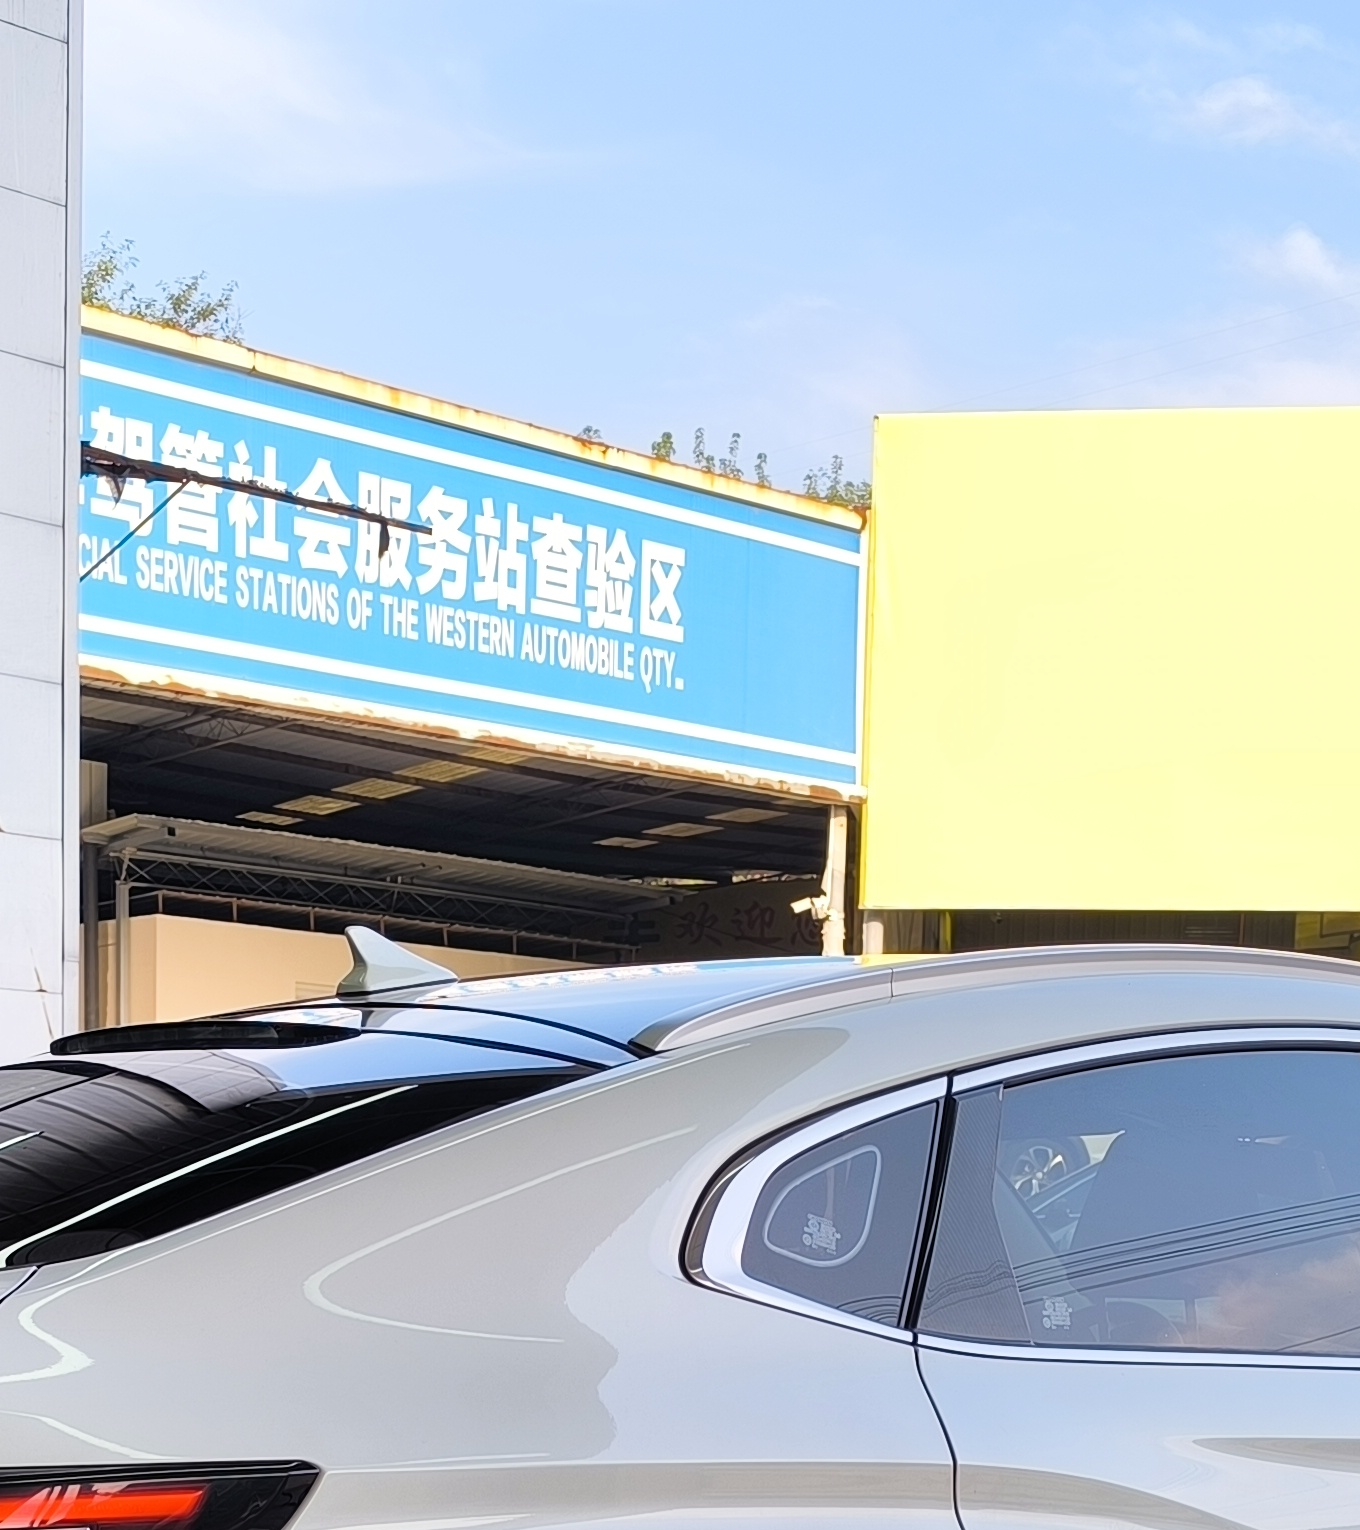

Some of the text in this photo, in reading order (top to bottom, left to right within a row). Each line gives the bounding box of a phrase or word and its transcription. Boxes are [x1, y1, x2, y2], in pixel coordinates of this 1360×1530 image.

[79, 405, 686, 644] 驾管社会服务站查验区
[135, 544, 228, 605] SERVICE
[234, 564, 339, 629] STATIONS
[346, 589, 373, 633] OF
[379, 594, 421, 642] THE
[423, 602, 516, 660] WESTERN
[519, 626, 636, 682] AUTOMOBILE
[639, 646, 686, 694] QTY.
